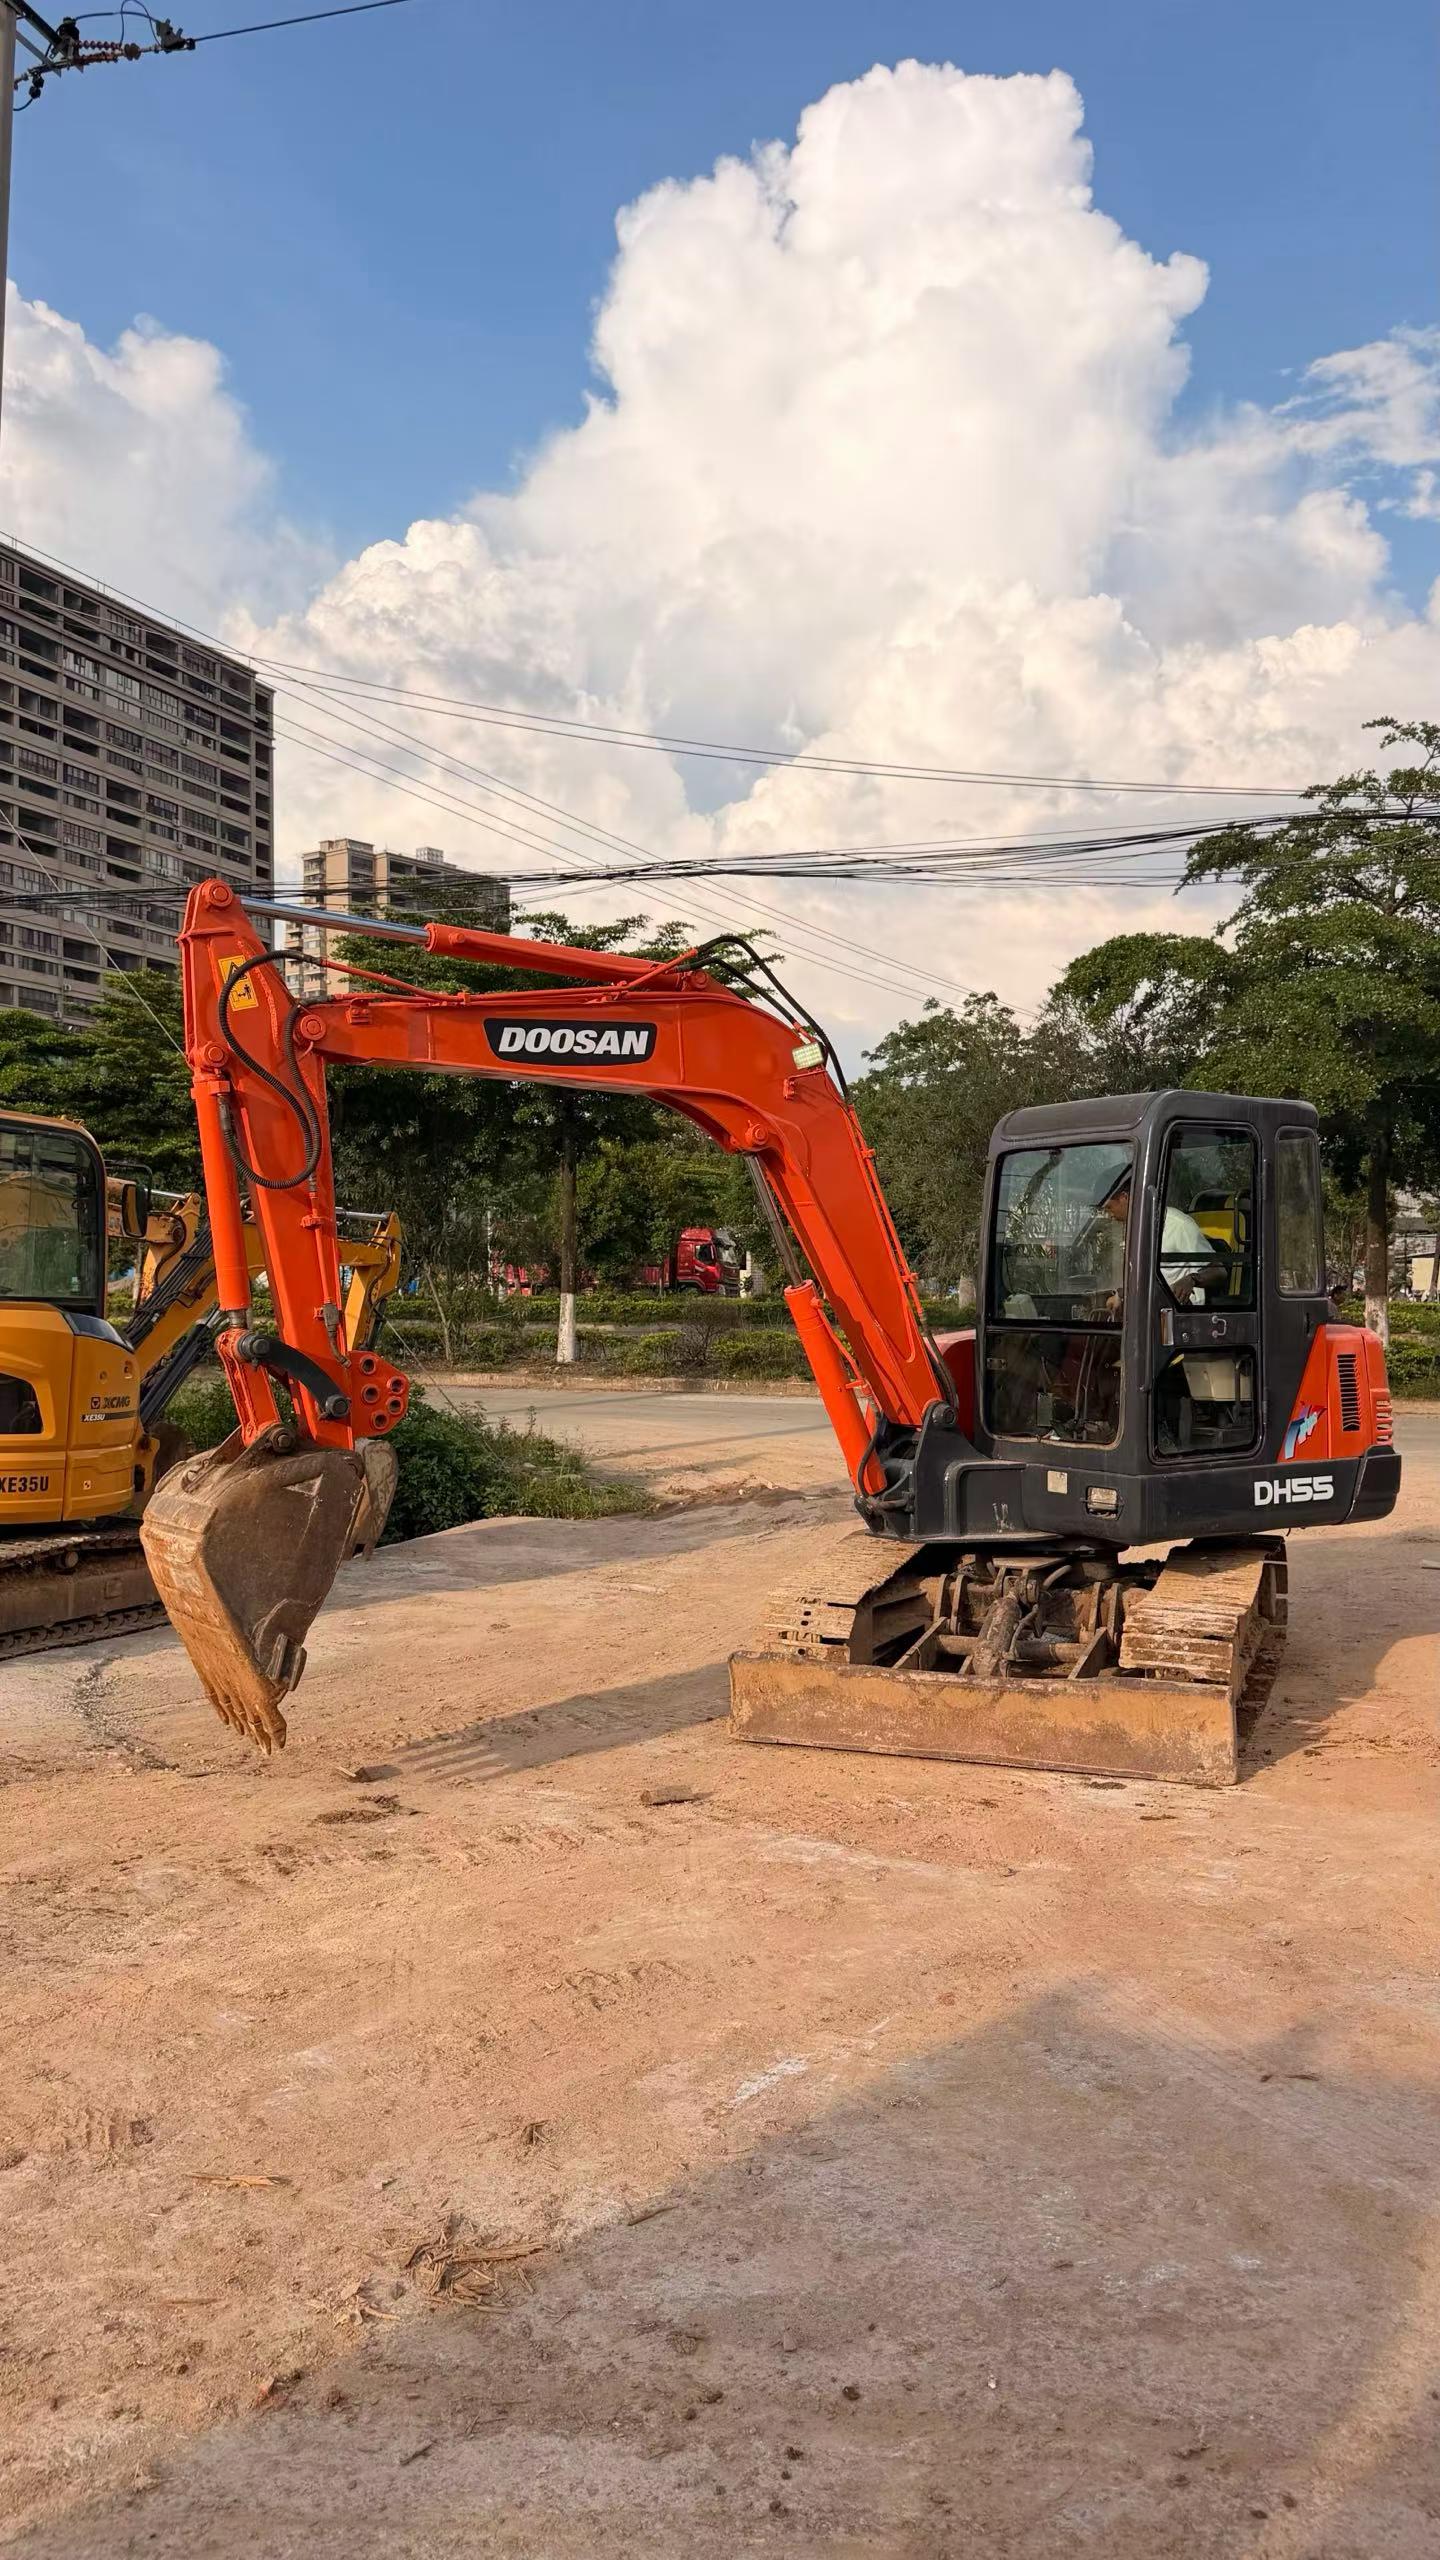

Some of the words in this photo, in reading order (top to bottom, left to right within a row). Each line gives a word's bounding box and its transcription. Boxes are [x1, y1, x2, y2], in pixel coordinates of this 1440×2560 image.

[499, 1027, 649, 1055] DOOSAN
[101, 1396, 131, 1409] XCMG
[83, 1413, 106, 1422] XE35U
[1254, 1475, 1334, 1506] DH55
